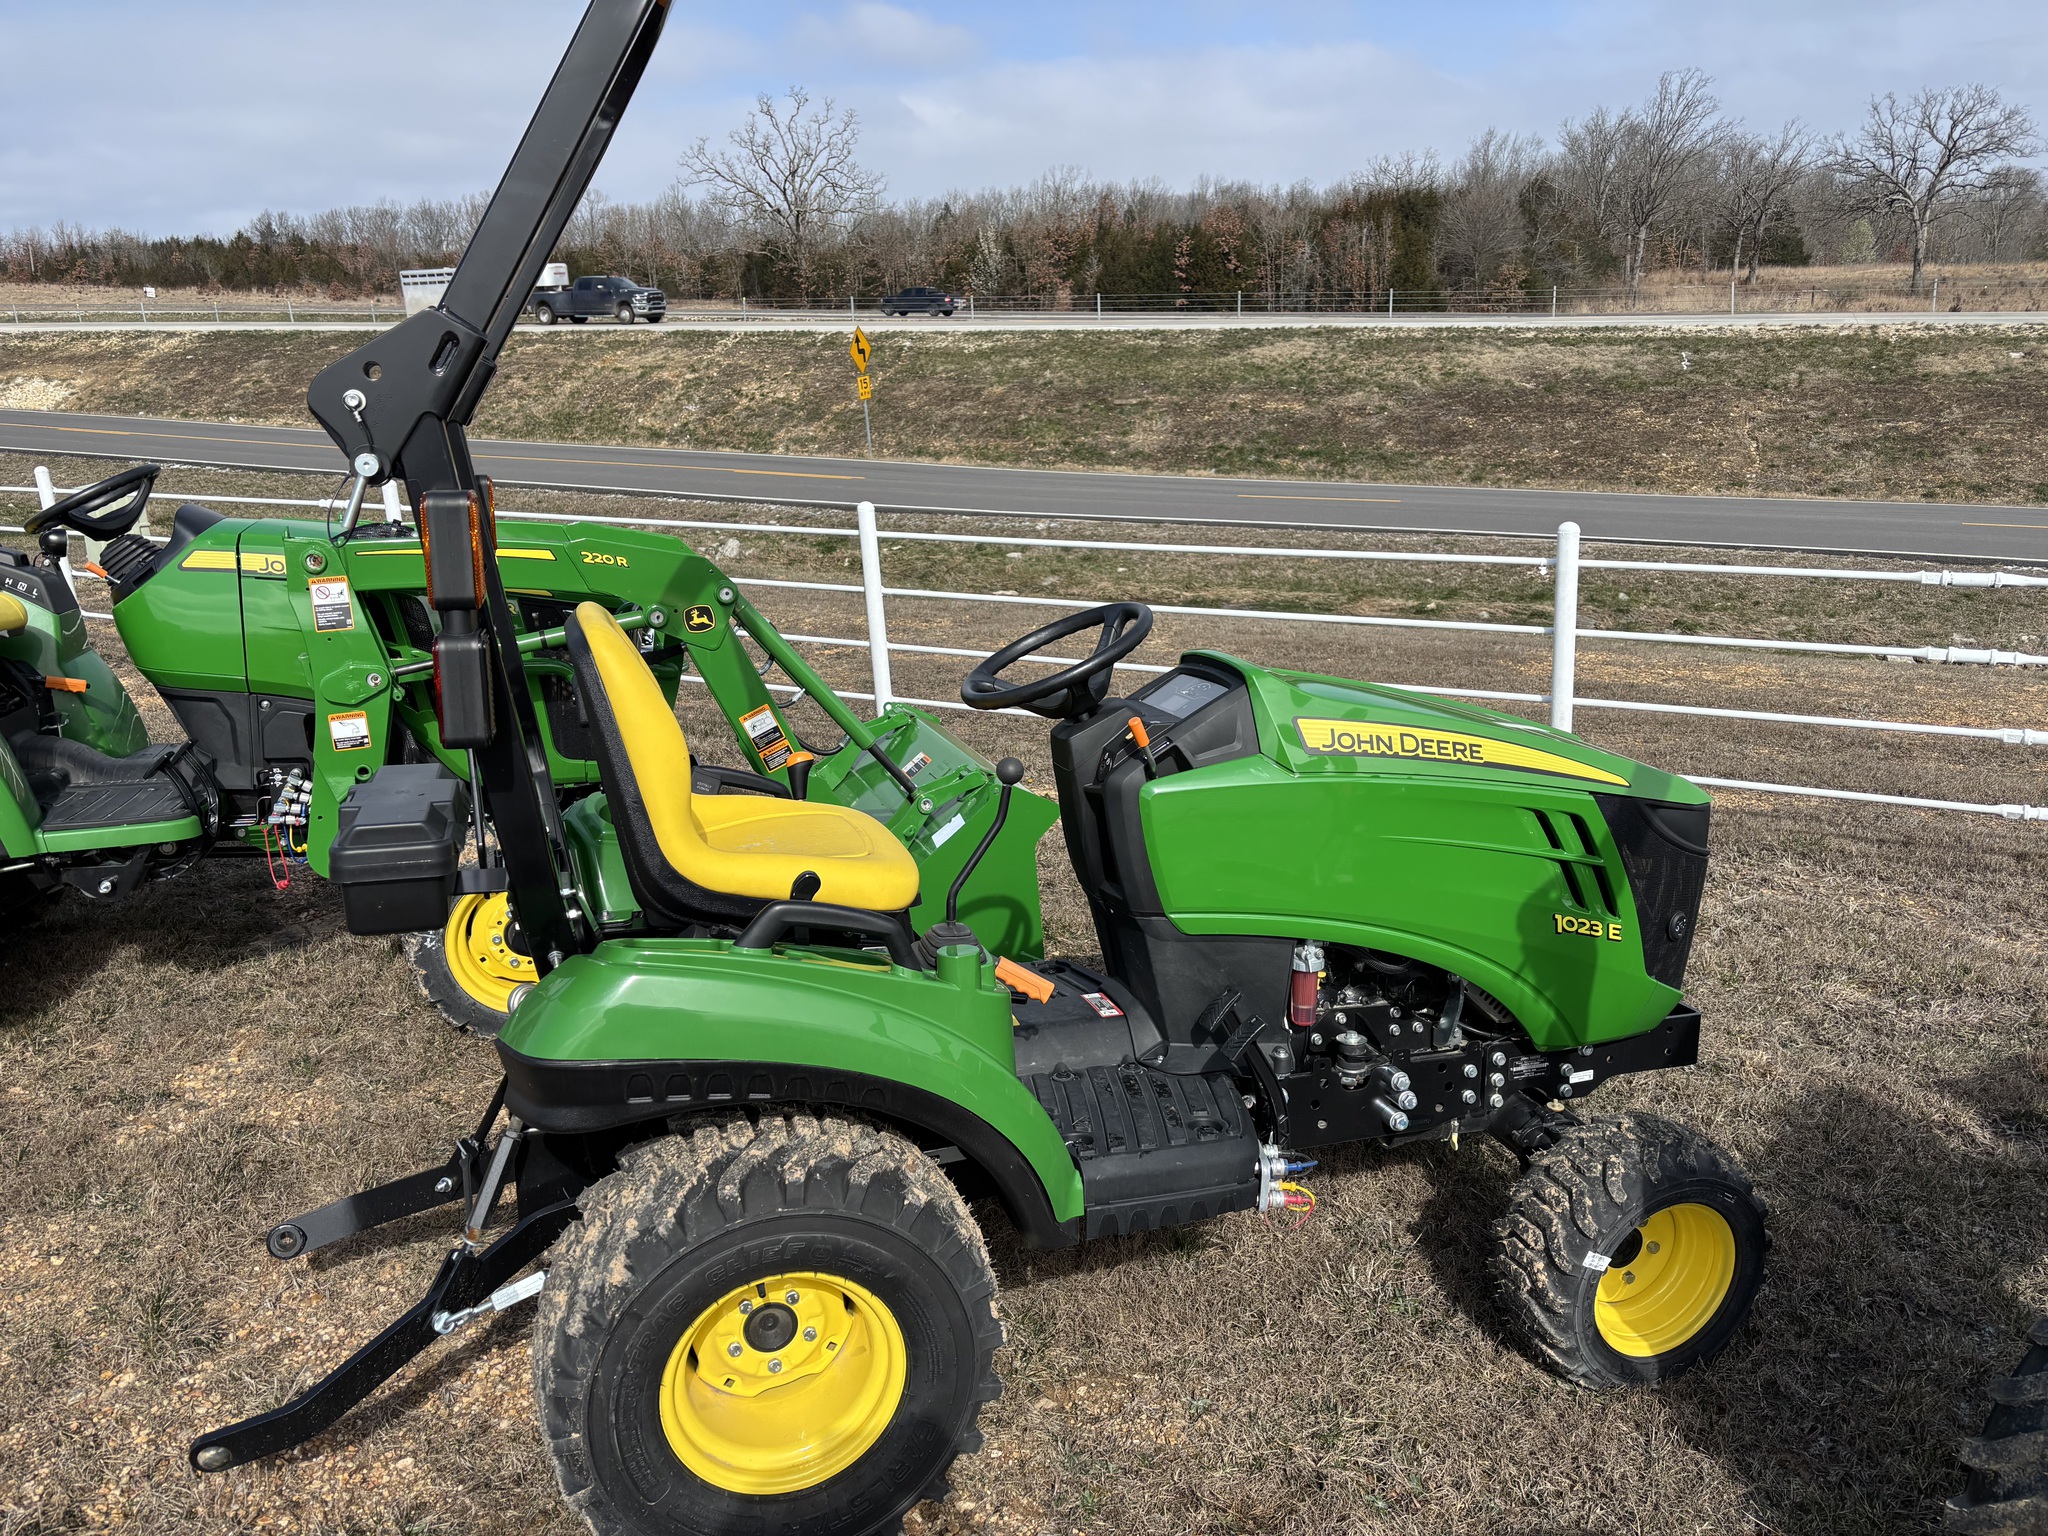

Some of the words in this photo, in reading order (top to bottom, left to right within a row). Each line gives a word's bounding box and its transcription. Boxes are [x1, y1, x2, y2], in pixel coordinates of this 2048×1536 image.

[860, 378, 868, 390] 15
[259, 557, 285, 572] JO
[316, 576, 346, 584] WARNING
[336, 712, 364, 720] WARNING
[1322, 728, 1394, 752] JOHN
[1399, 732, 1484, 761] DEERE
[704, 1241, 807, 1288] CHIEF
